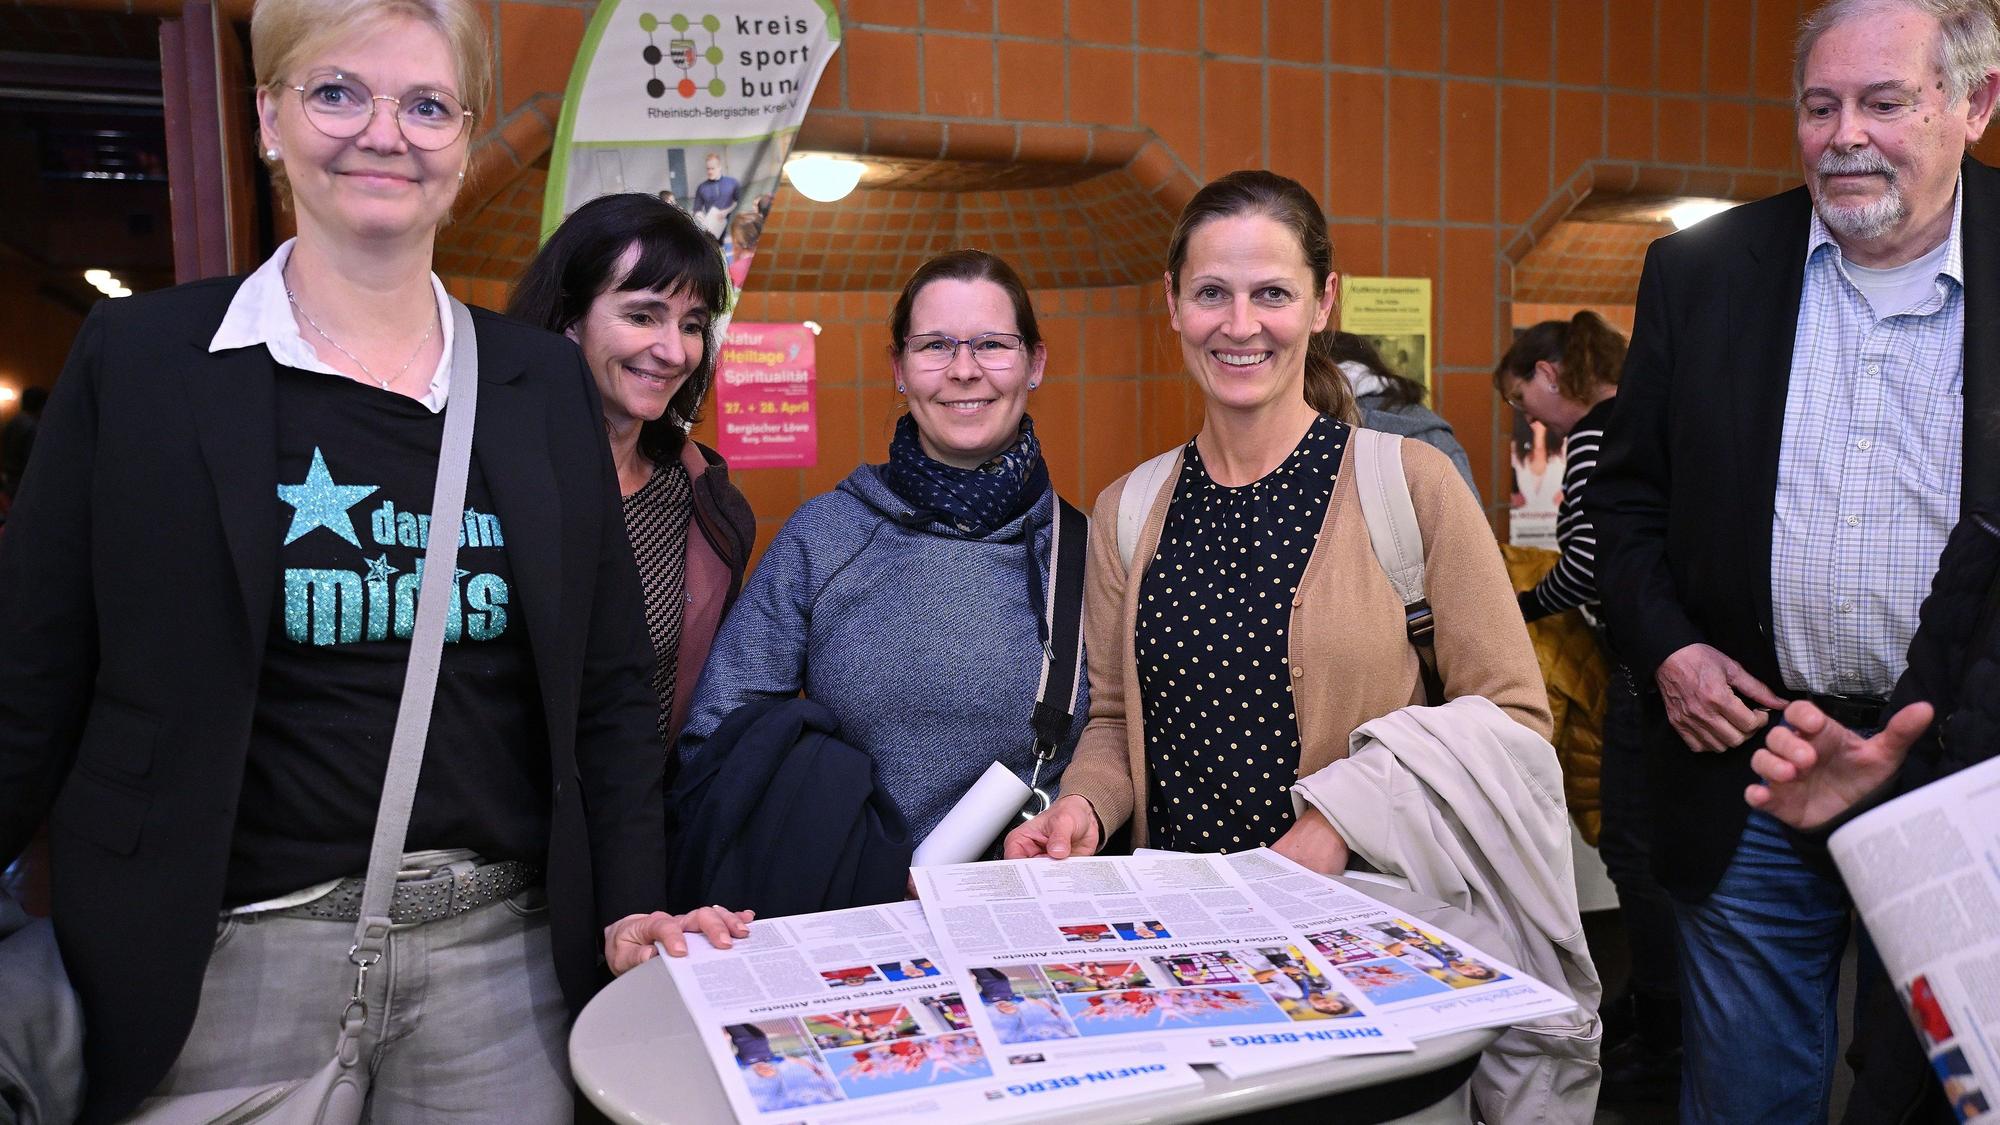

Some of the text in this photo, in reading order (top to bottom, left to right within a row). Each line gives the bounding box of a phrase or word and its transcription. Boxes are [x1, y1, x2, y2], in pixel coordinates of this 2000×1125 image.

[735, 15, 808, 35] kreis
[740, 45, 809, 70] sport
[647, 105, 760, 120] Rheinisch-Bergischer
[726, 332, 763, 346] Natur
[725, 369, 808, 386] Spiritualität
[725, 401, 744, 414] 27.
[760, 401, 777, 414] 28.
[781, 401, 809, 416] April
[727, 423, 809, 435] Bergischer Löwe
[372, 500, 504, 548] danin
[992, 935, 1288, 961] Großer Applaus für Rhein-Bergs beste Athleten
[1229, 1026, 1384, 1046] RHEIN-BERG
